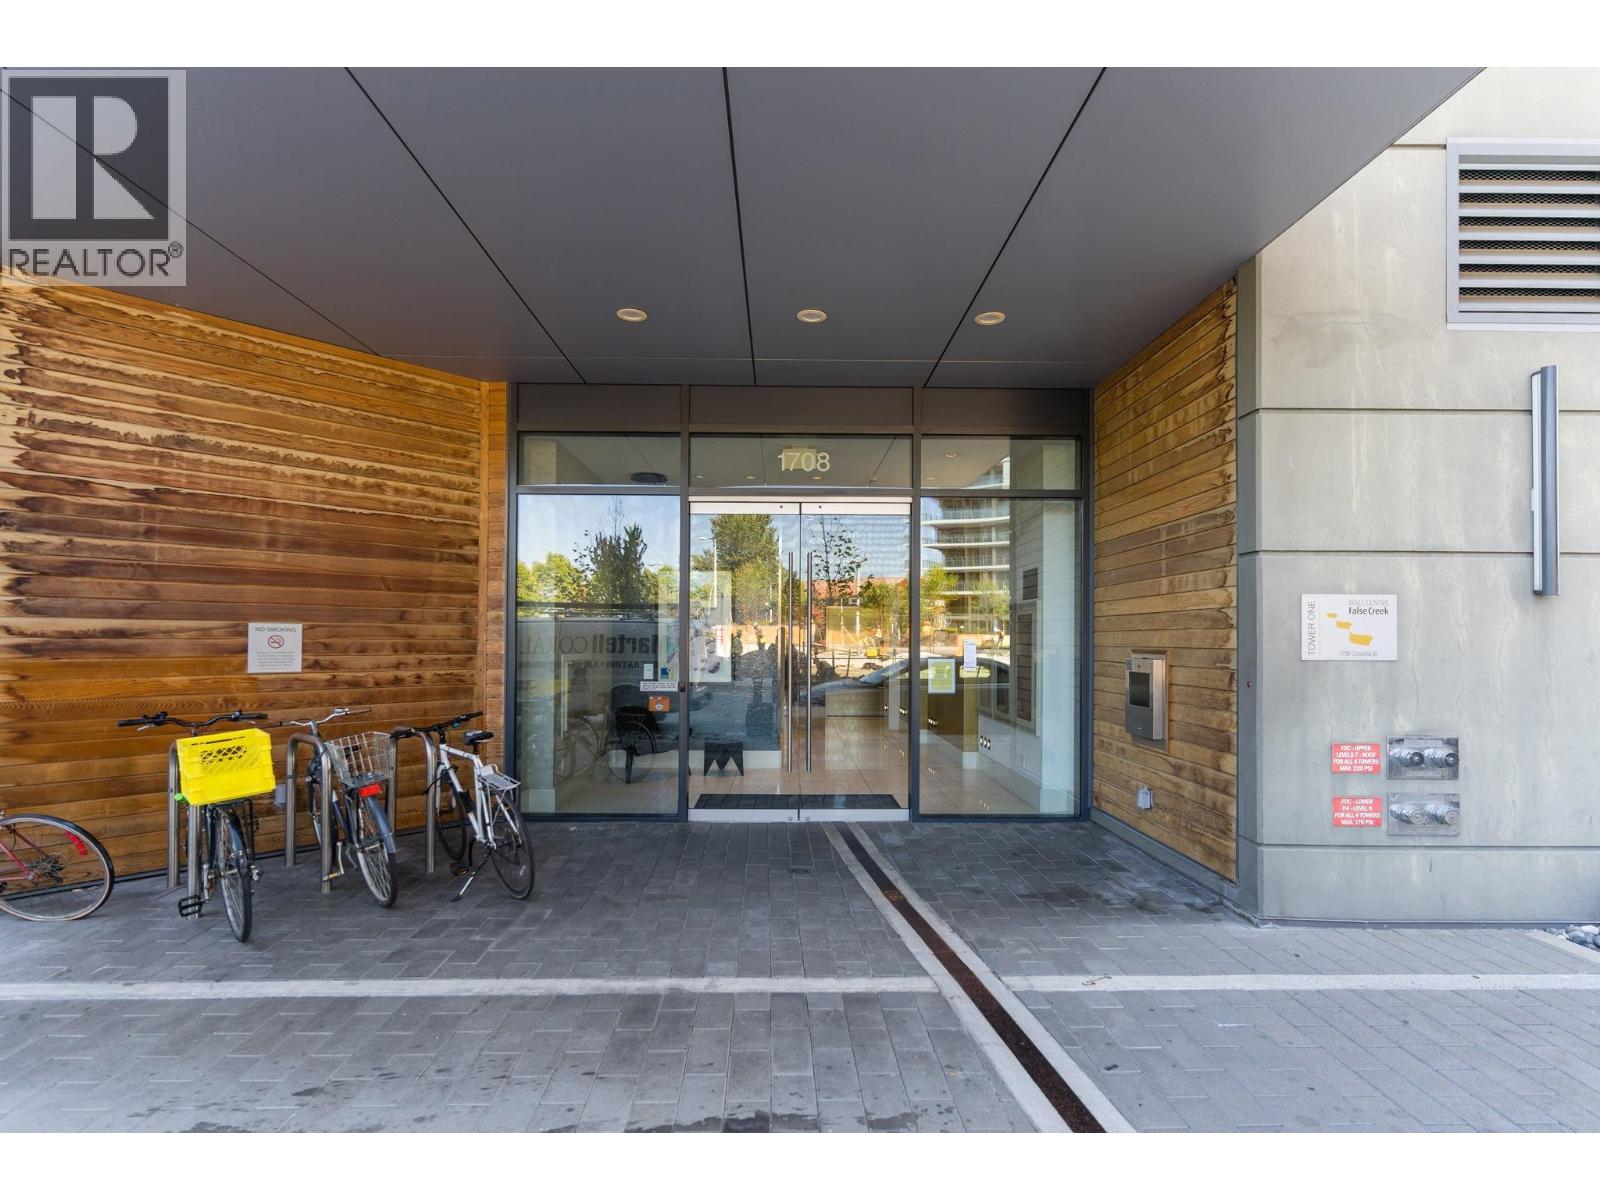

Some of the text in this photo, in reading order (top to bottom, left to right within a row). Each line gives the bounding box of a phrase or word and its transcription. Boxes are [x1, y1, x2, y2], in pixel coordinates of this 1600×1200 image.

[777, 452, 830, 471] 1708
[1348, 606, 1389, 615] False Creek
[1307, 600, 1316, 656] TOWER ONE
